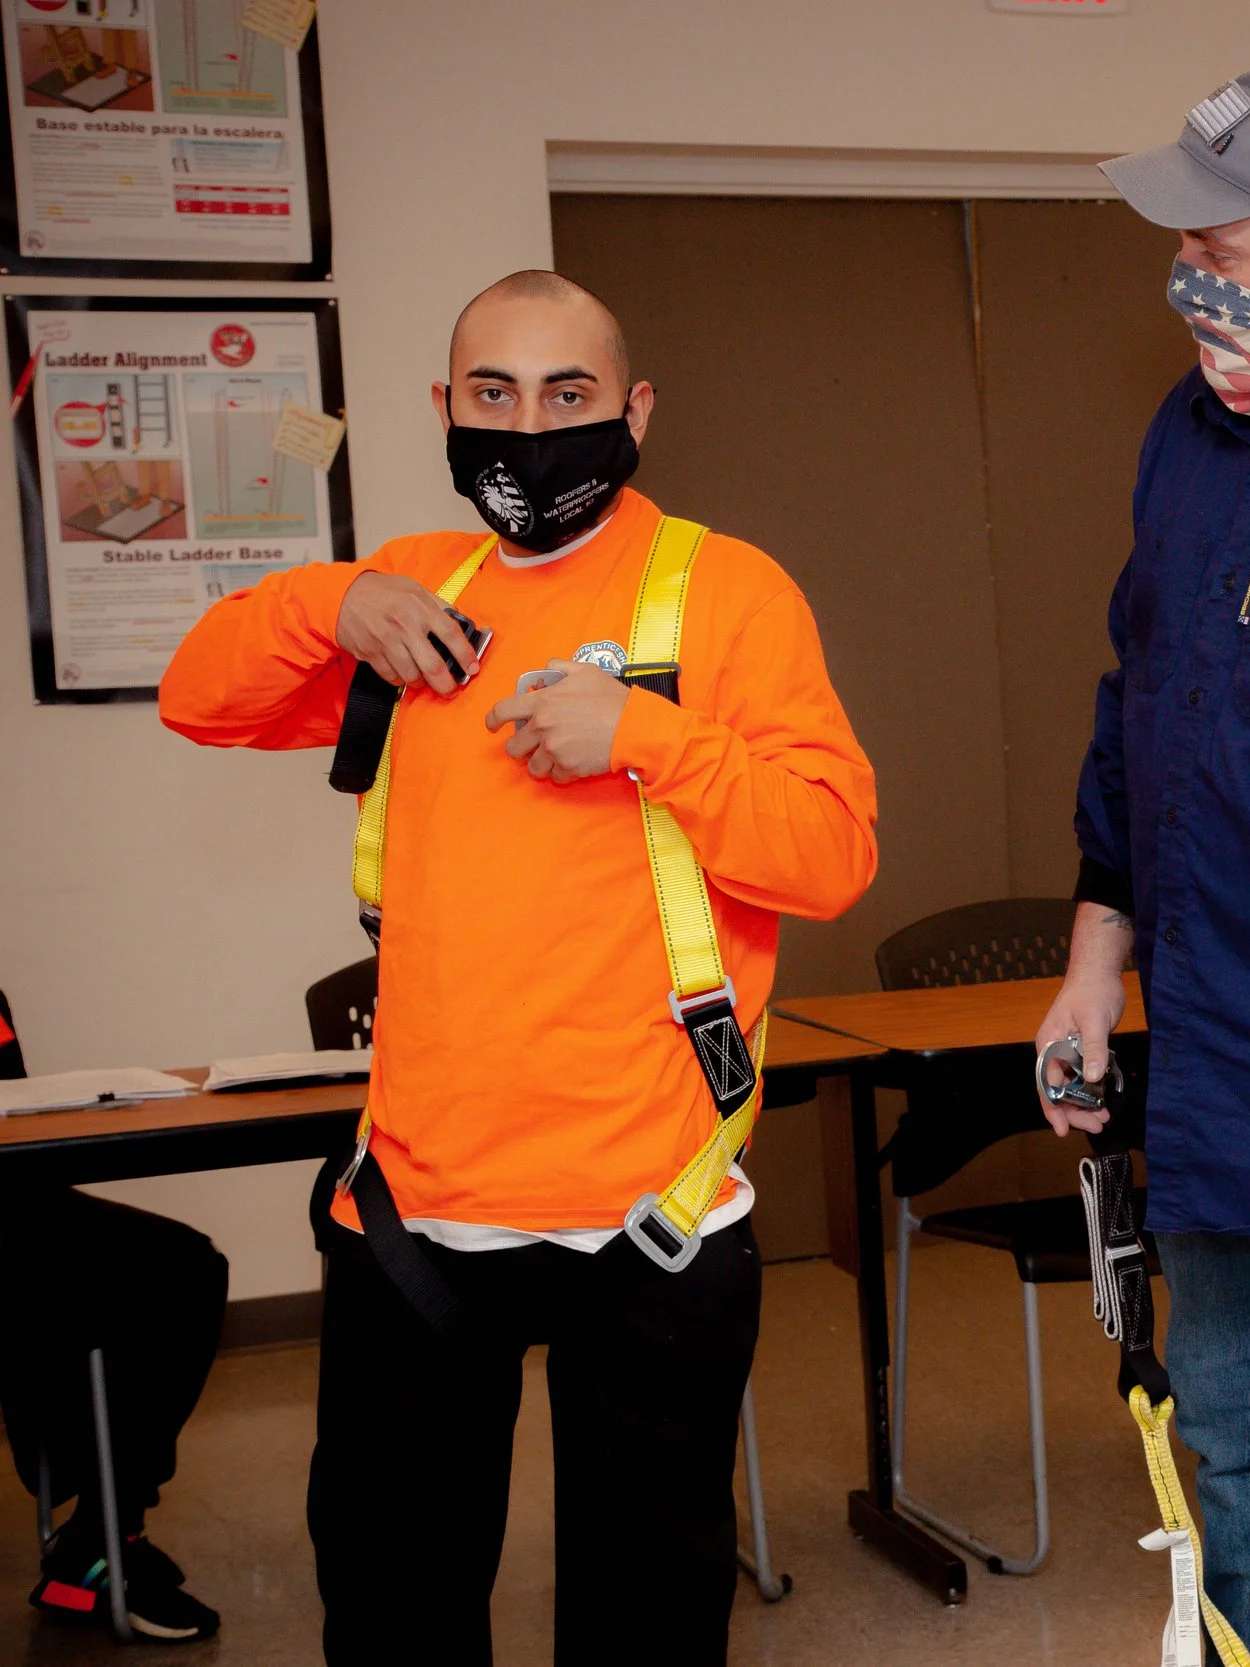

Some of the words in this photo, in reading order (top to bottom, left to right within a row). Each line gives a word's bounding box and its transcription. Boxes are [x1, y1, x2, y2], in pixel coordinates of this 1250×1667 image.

[36, 118, 78, 131] Base
[84, 120, 146, 134] estable
[151, 124, 188, 138] para
[193, 124, 208, 136] la
[213, 126, 284, 140] escalera
[45, 352, 108, 368] Ladder
[114, 352, 208, 370] Alignment
[543, 482, 609, 519] WATERPROOFERS
[555, 482, 591, 505] ROOFERS
[559, 506, 584, 523] LOCAL
[103, 549, 163, 563] Stable
[170, 548, 232, 562] Ladder
[238, 546, 283, 560] Base
[572, 642, 627, 666] APPRENTICESH
